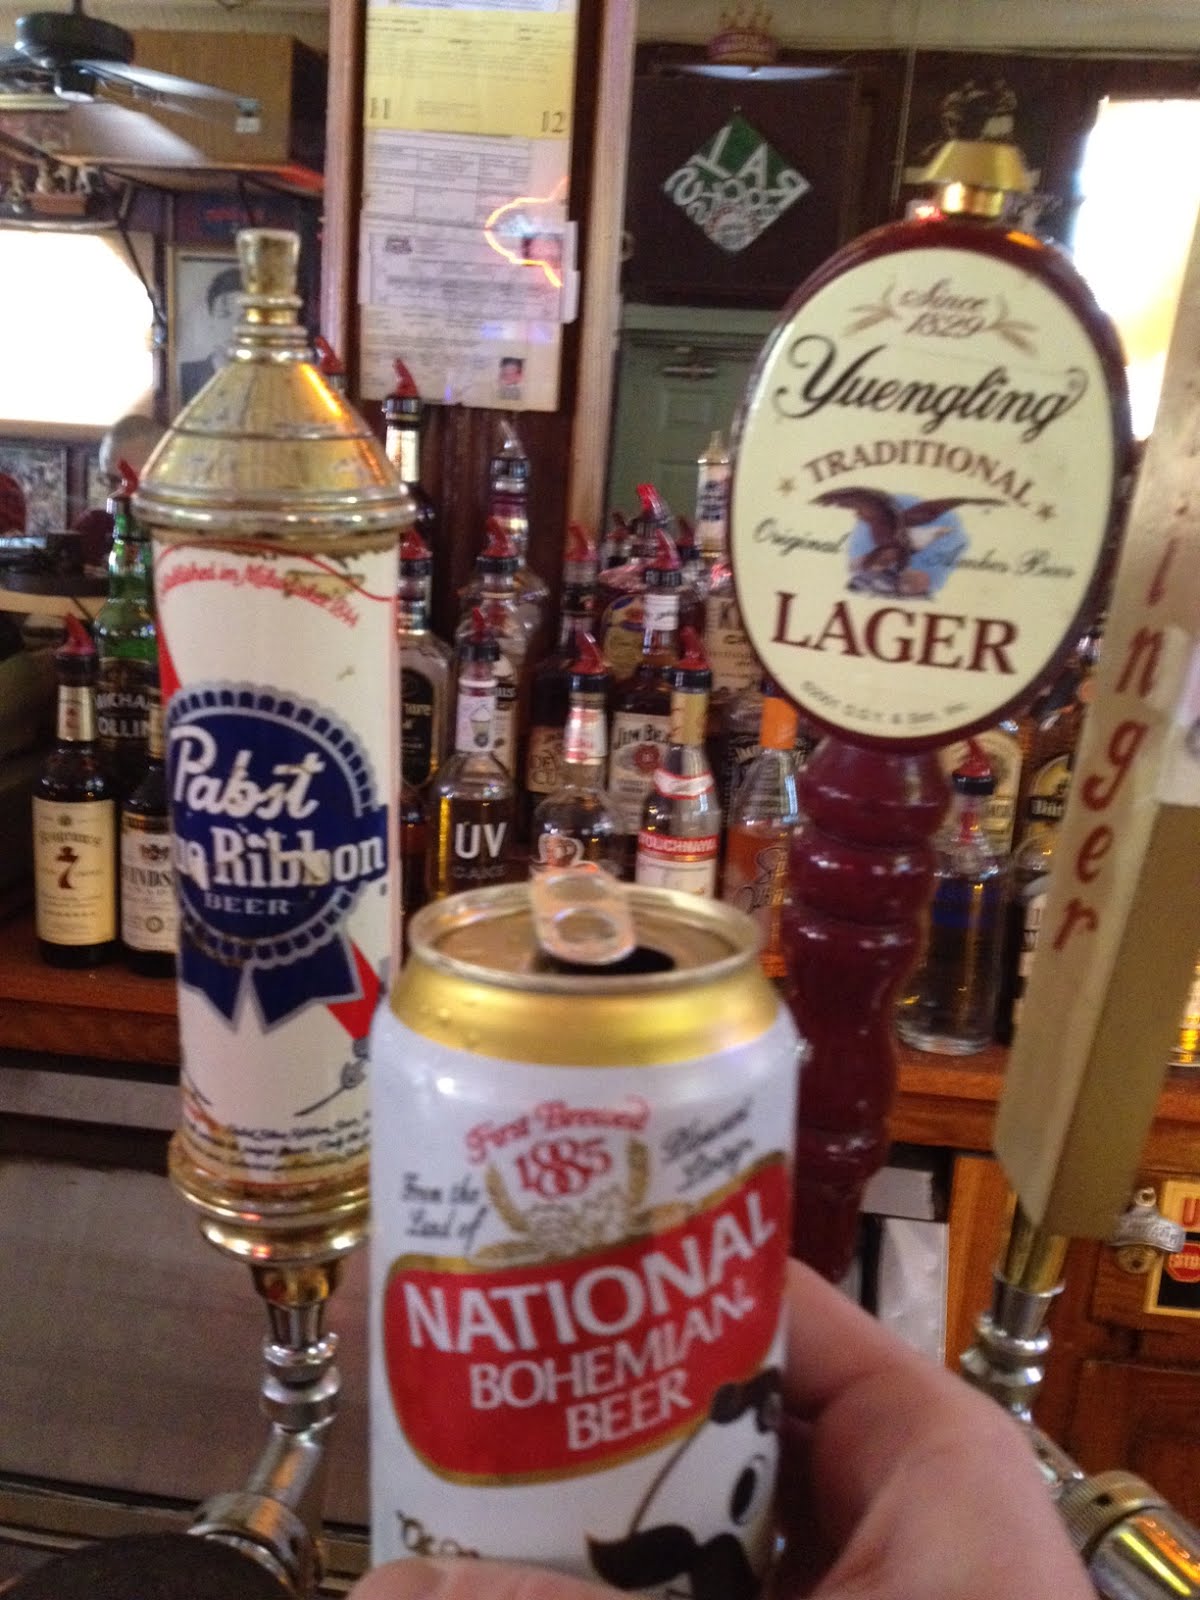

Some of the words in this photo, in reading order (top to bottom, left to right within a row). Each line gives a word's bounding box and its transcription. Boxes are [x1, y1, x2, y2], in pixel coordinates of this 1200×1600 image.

[902, 278, 990, 312] Since
[905, 313, 987, 338] 1829
[774, 334, 1088, 444] Yuengling
[803, 439, 1036, 509] TRADITIONAL
[753, 517, 851, 556] Original
[771, 590, 1019, 676] LAGER
[170, 724, 326, 820] Pabst
[209, 827, 386, 888] Ribbon
[454, 821, 507, 859] UV
[56, 854, 80, 890] 7
[203, 891, 290, 915] BEER
[515, 1137, 613, 1201] 1885
[403, 1191, 776, 1354] NATIONAL
[566, 1368, 694, 1451] BEER
